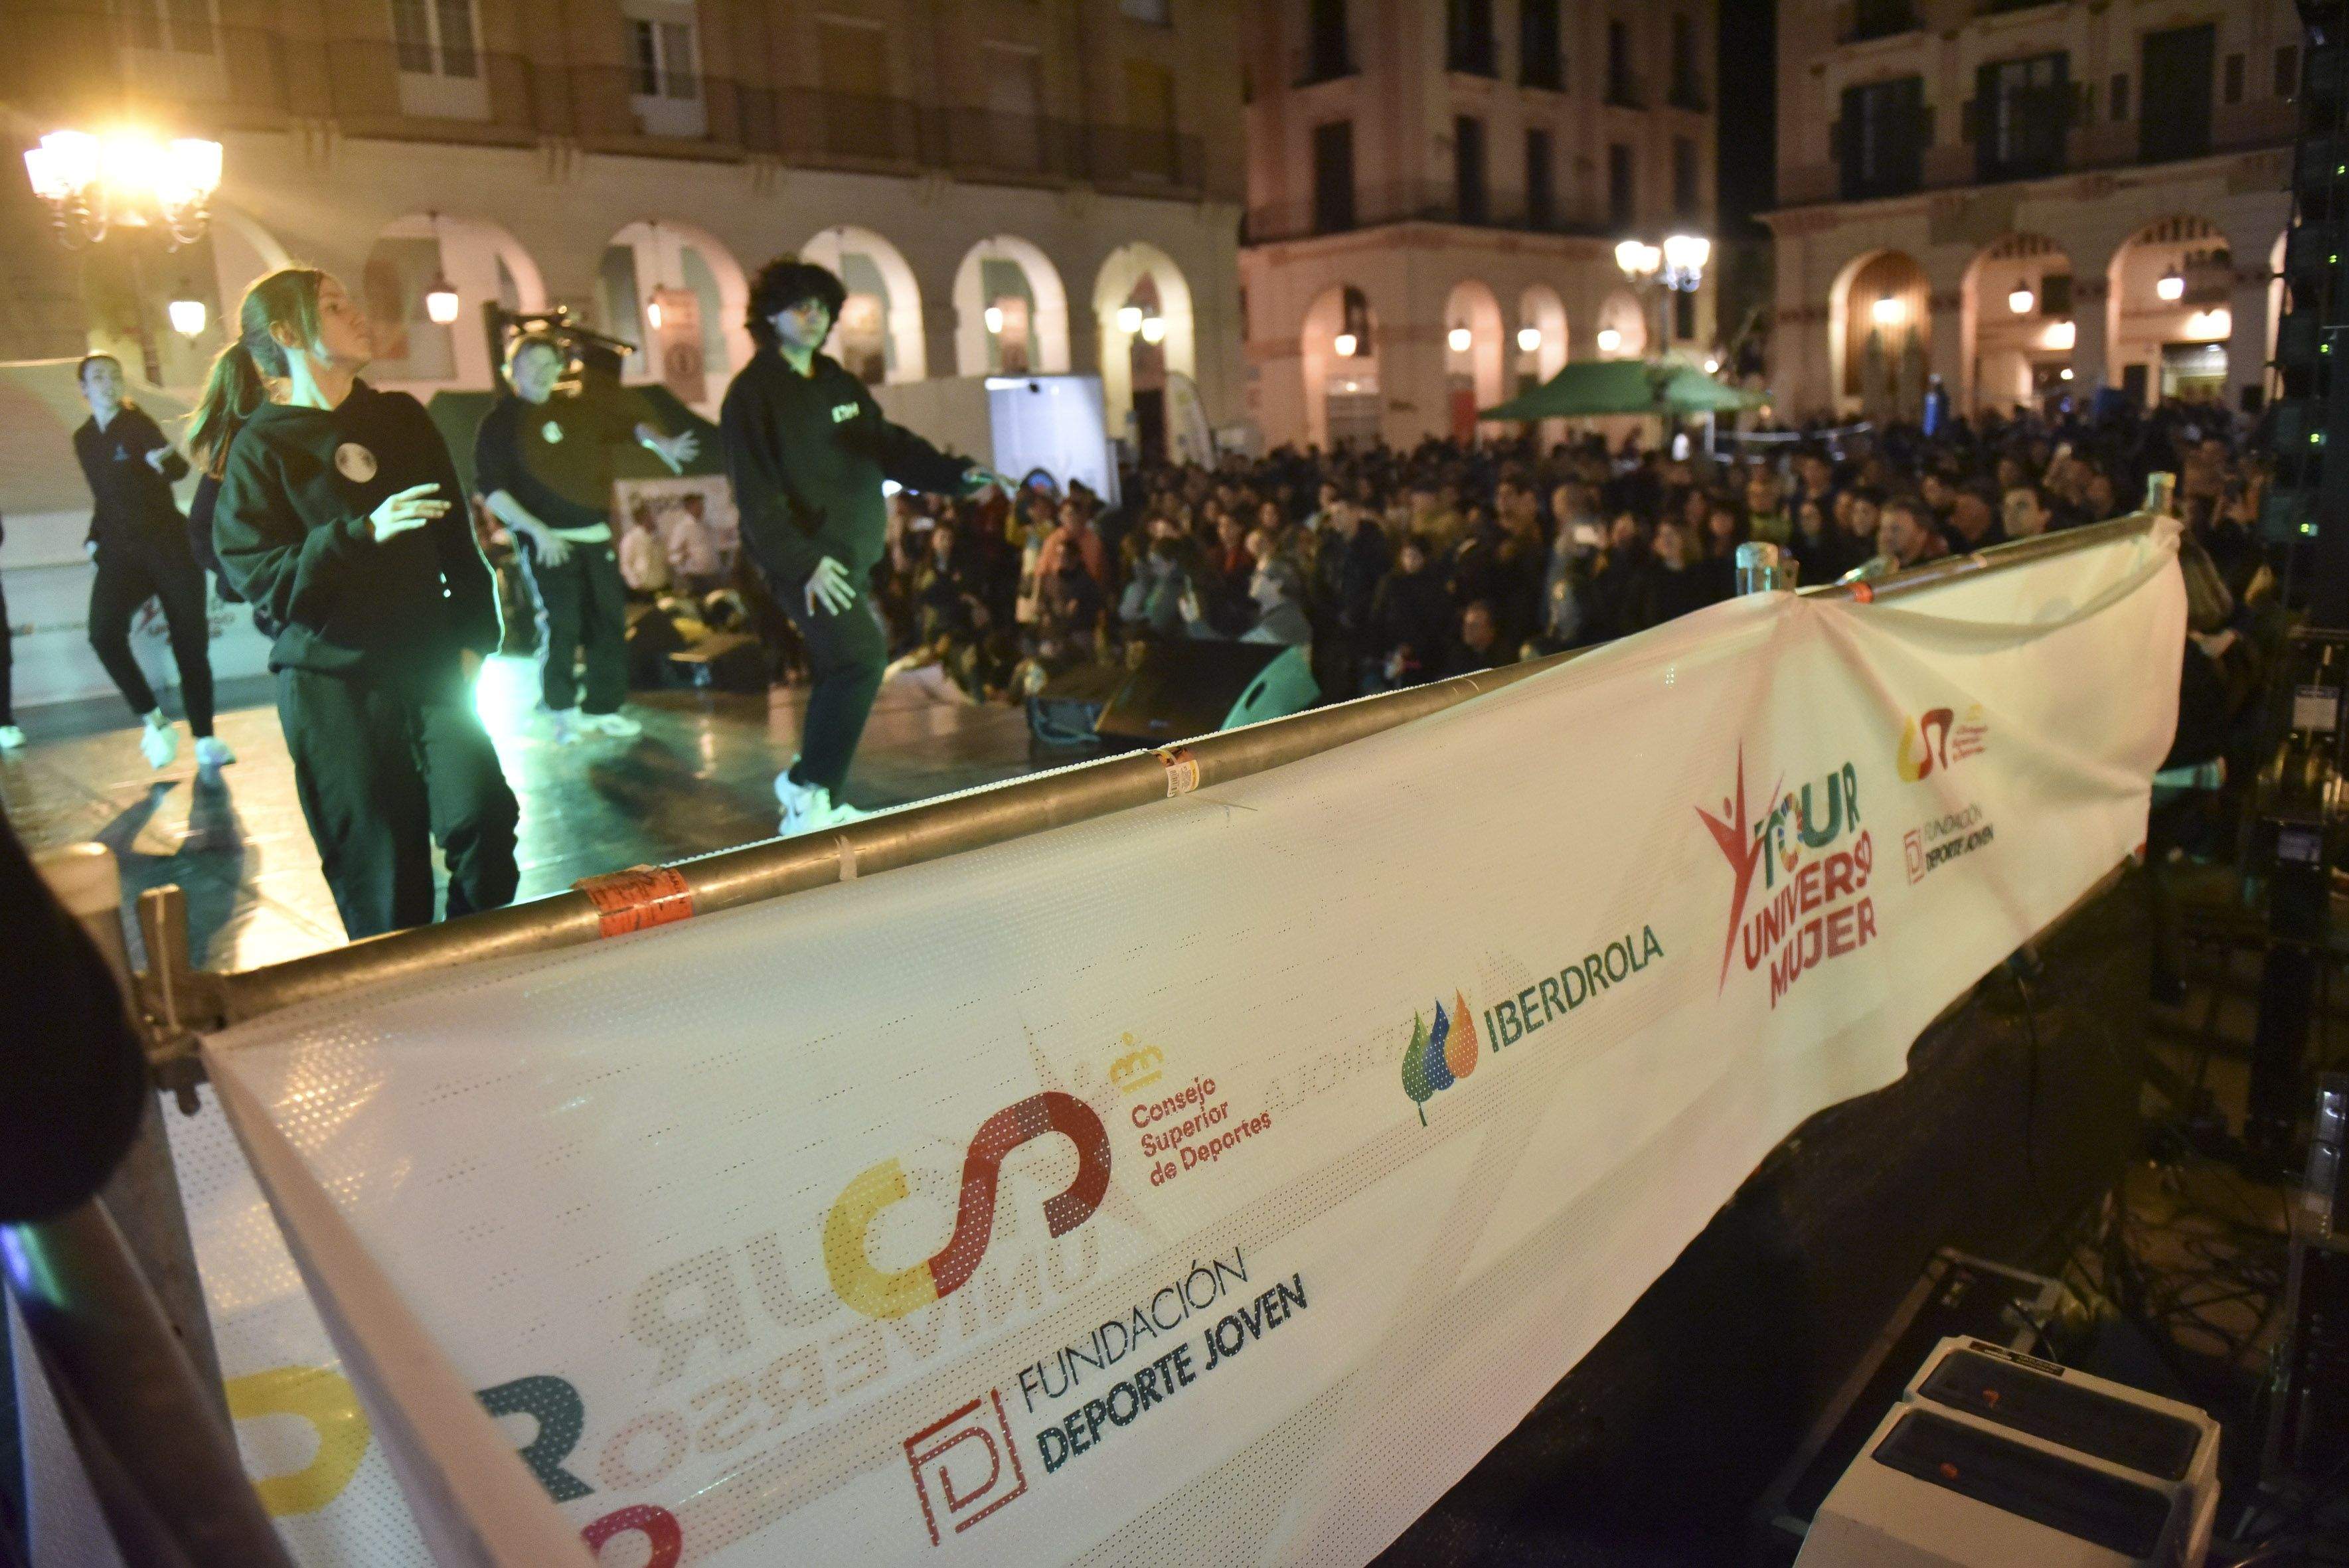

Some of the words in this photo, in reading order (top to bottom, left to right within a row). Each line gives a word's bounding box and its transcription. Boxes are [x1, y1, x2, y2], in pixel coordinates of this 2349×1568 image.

[1754, 761, 1860, 890] TOUR
[1743, 829, 1873, 971] UNIVERSO
[1771, 896, 1877, 1010] MUJER
[1484, 924, 1664, 1054] IBERDROLA
[1131, 1077, 1216, 1128] Consejo
[1141, 1101, 1228, 1157] Superior
[1150, 1161, 1177, 1186] de
[1180, 1113, 1271, 1171] Deportes
[1018, 1246, 1249, 1413] FUNDACIÓN
[1036, 1344, 1196, 1474] DEPORTE
[1205, 1273, 1307, 1372] JOVEN
